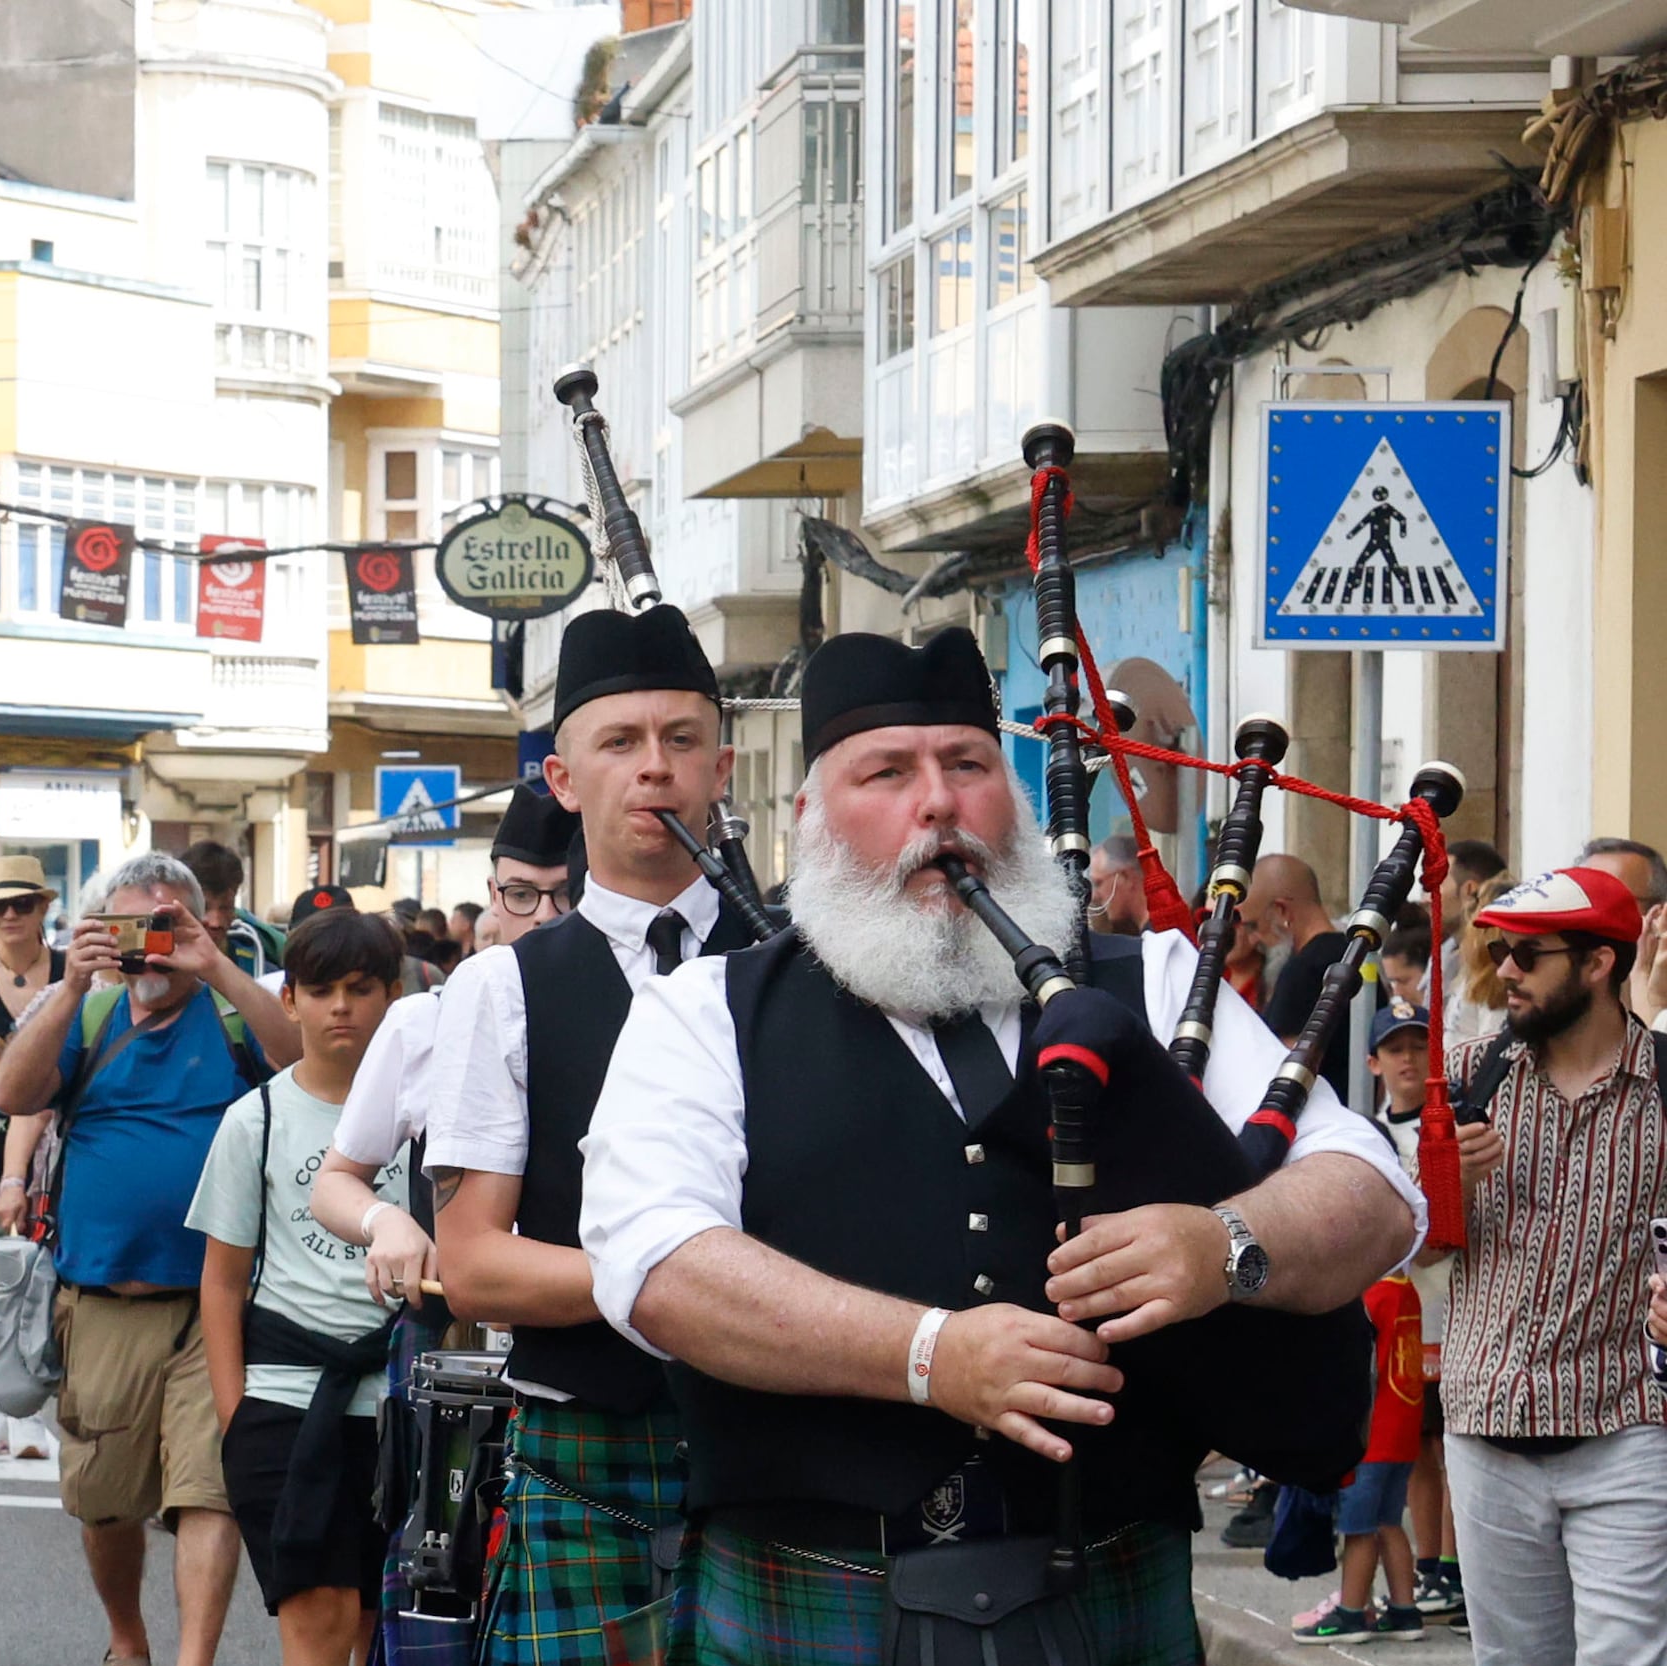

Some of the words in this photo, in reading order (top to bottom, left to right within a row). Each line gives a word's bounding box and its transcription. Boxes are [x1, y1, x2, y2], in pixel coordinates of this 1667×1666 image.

[462, 535, 570, 562] Estrella
[465, 564, 566, 591] Galicia
[300, 1231, 336, 1259] ALL
